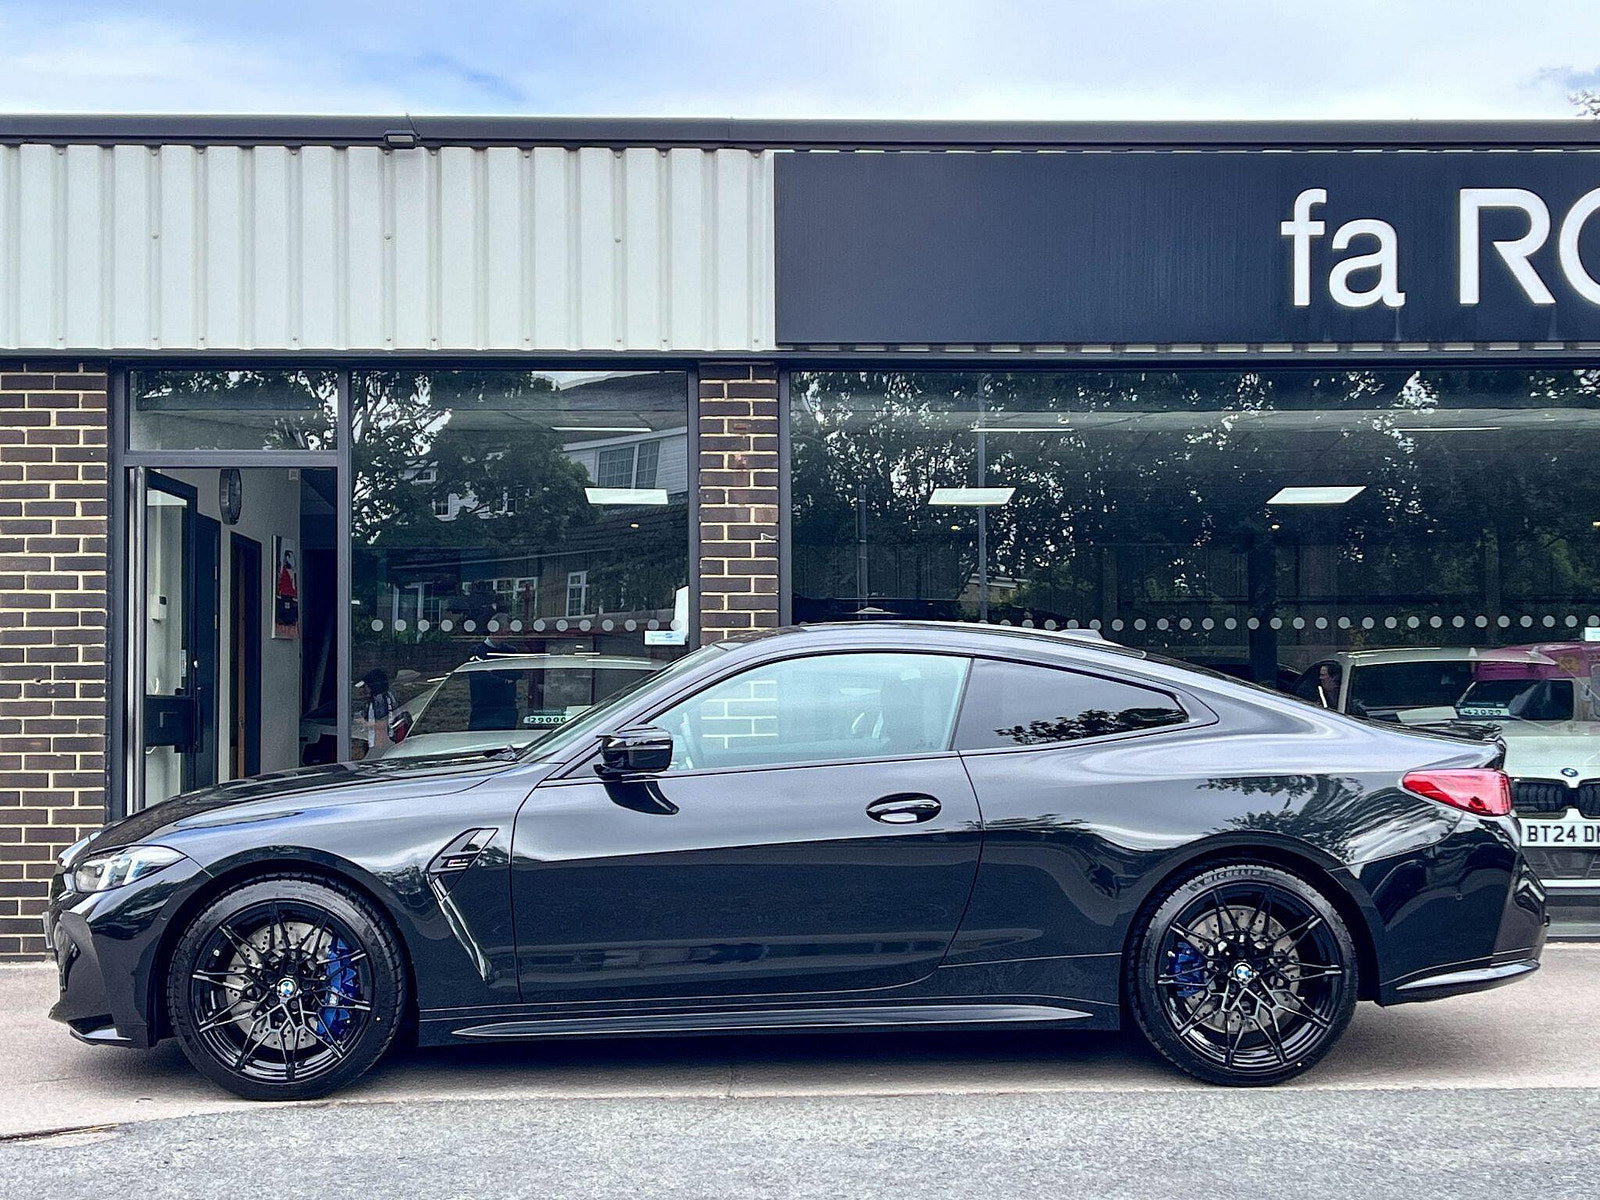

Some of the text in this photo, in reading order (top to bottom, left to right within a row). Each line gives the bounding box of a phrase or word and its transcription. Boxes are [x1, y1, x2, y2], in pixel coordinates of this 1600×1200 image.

[1280, 188, 1406, 307] fa
[1526, 825, 1600, 842] BT24 D
[1203, 869, 1261, 885] MICHELIN
